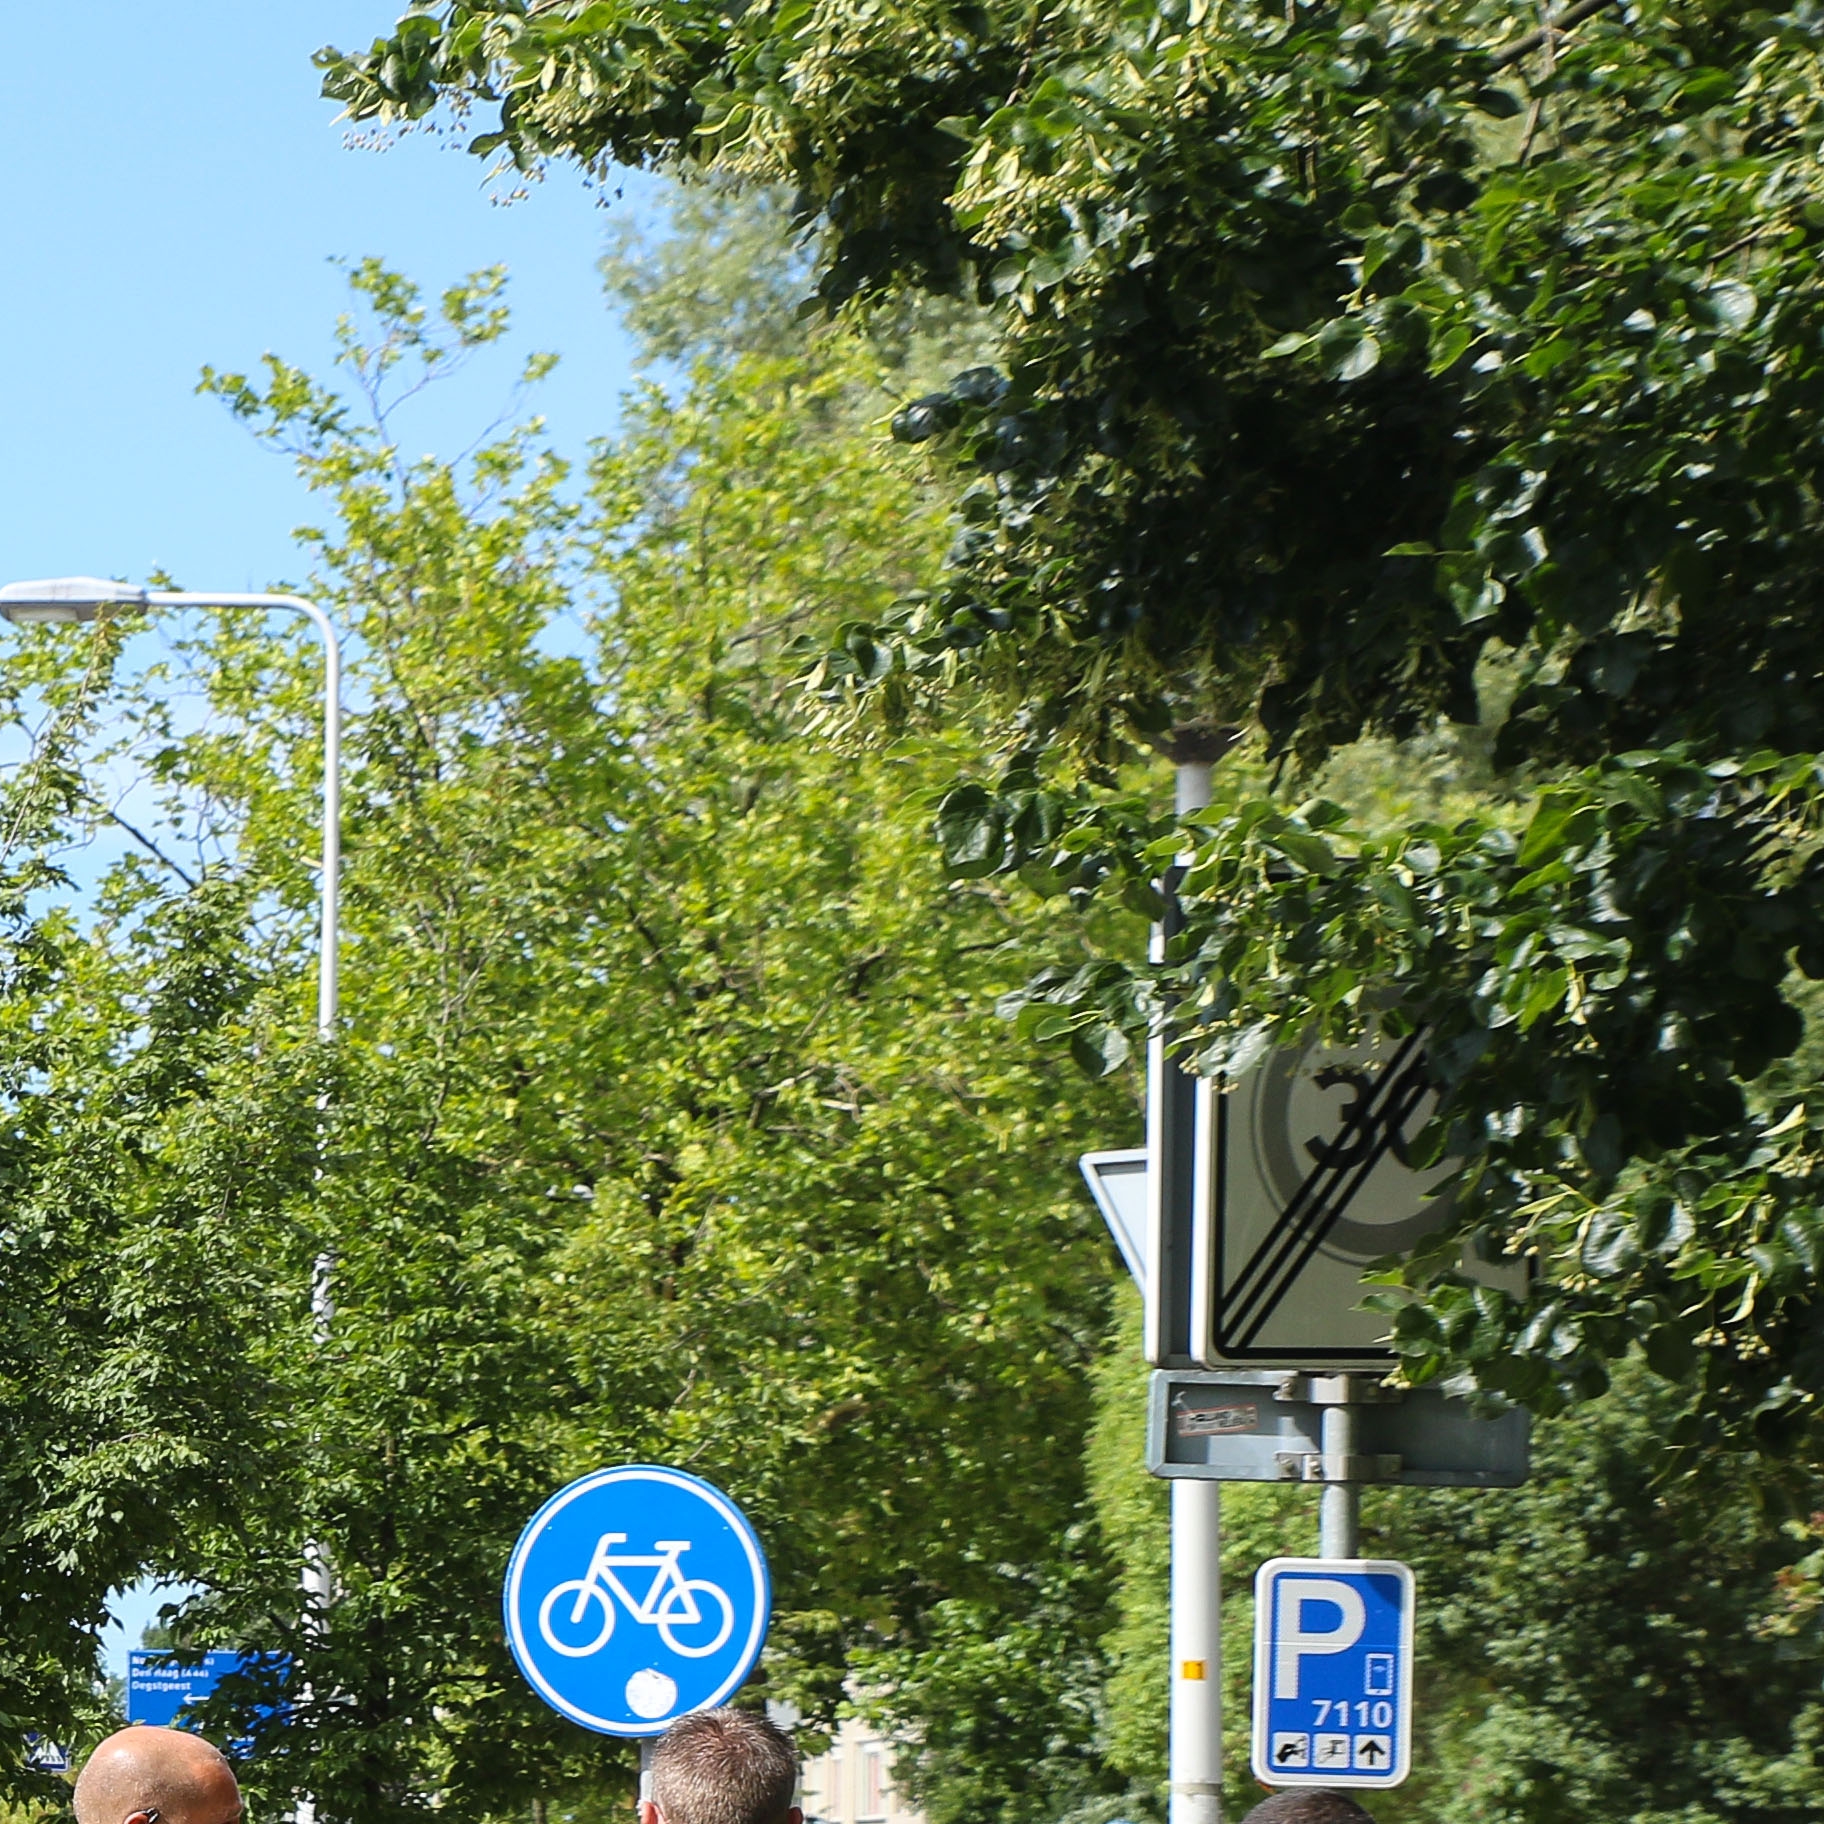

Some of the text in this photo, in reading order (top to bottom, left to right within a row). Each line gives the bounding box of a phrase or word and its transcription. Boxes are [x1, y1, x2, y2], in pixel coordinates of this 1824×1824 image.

[1274, 1578, 1366, 1699] P
[132, 1681, 191, 1692] Oegstgeest
[1312, 1700, 1393, 1729] 7110
